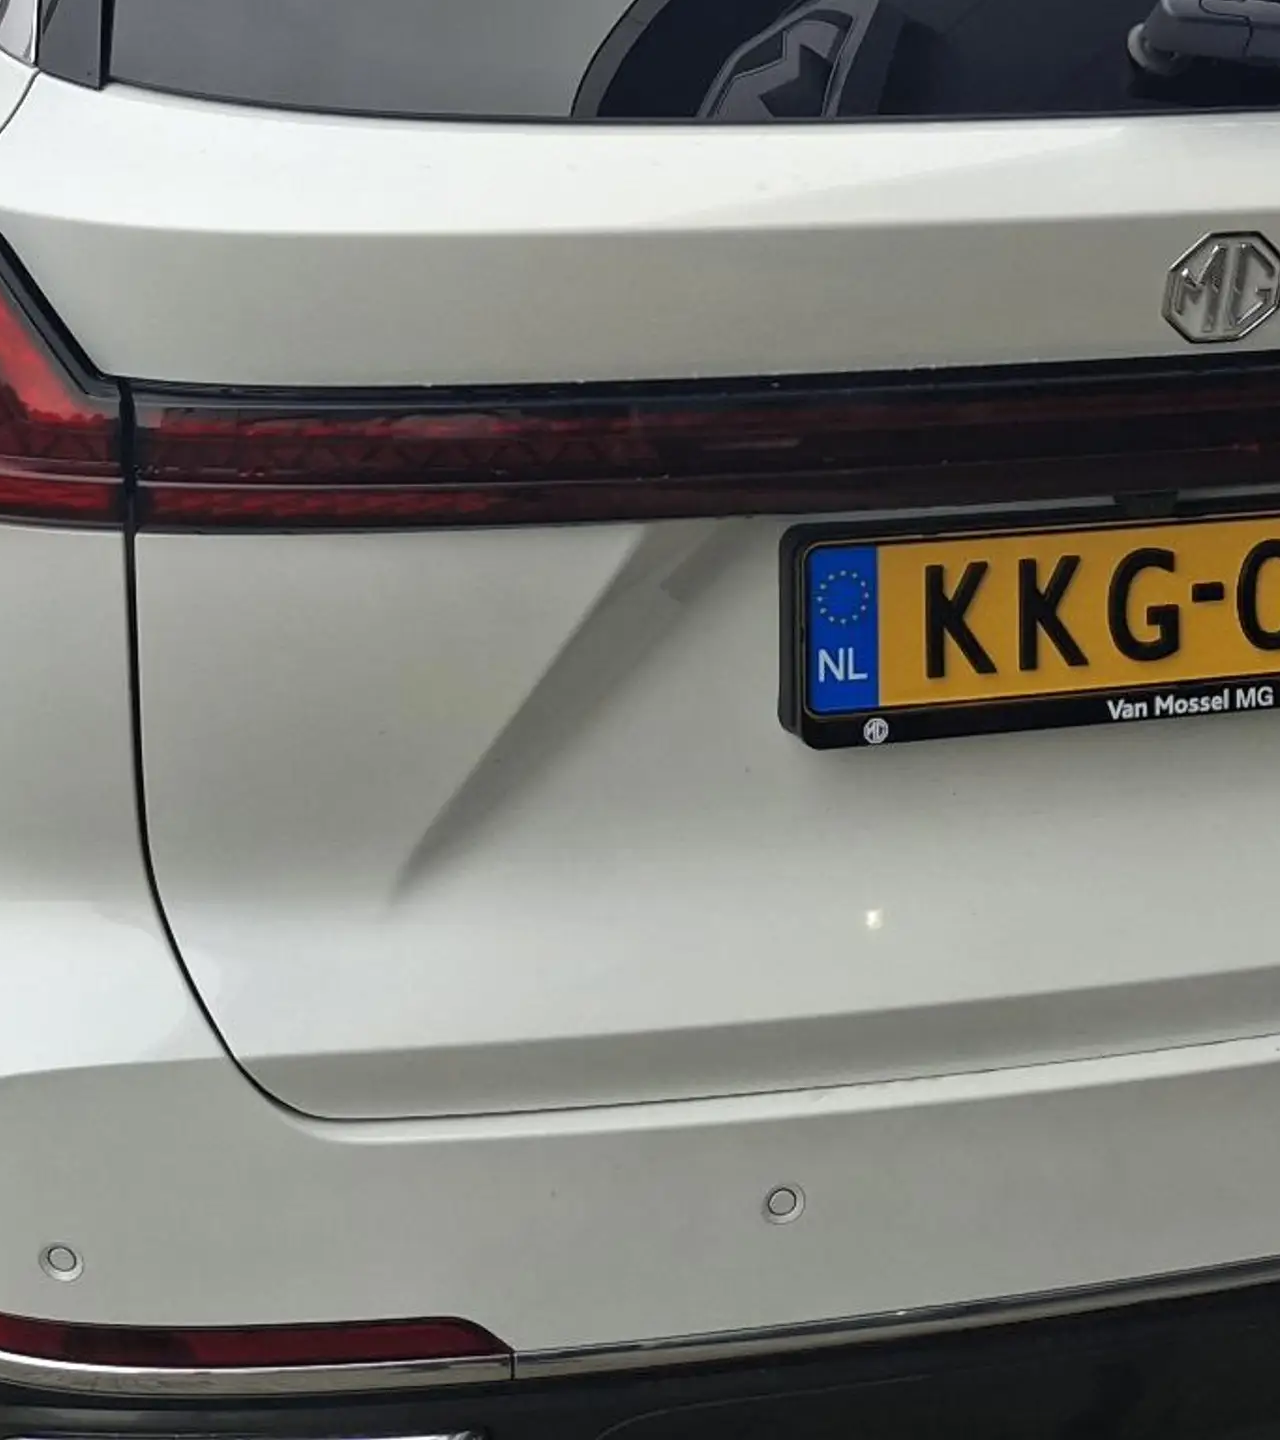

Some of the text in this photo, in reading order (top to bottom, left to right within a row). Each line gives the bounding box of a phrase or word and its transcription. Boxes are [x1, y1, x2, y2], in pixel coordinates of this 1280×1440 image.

[1172, 242, 1278, 335] MG
[817, 646, 869, 683] NL
[1106, 685, 1275, 721] Van Mossel MG
